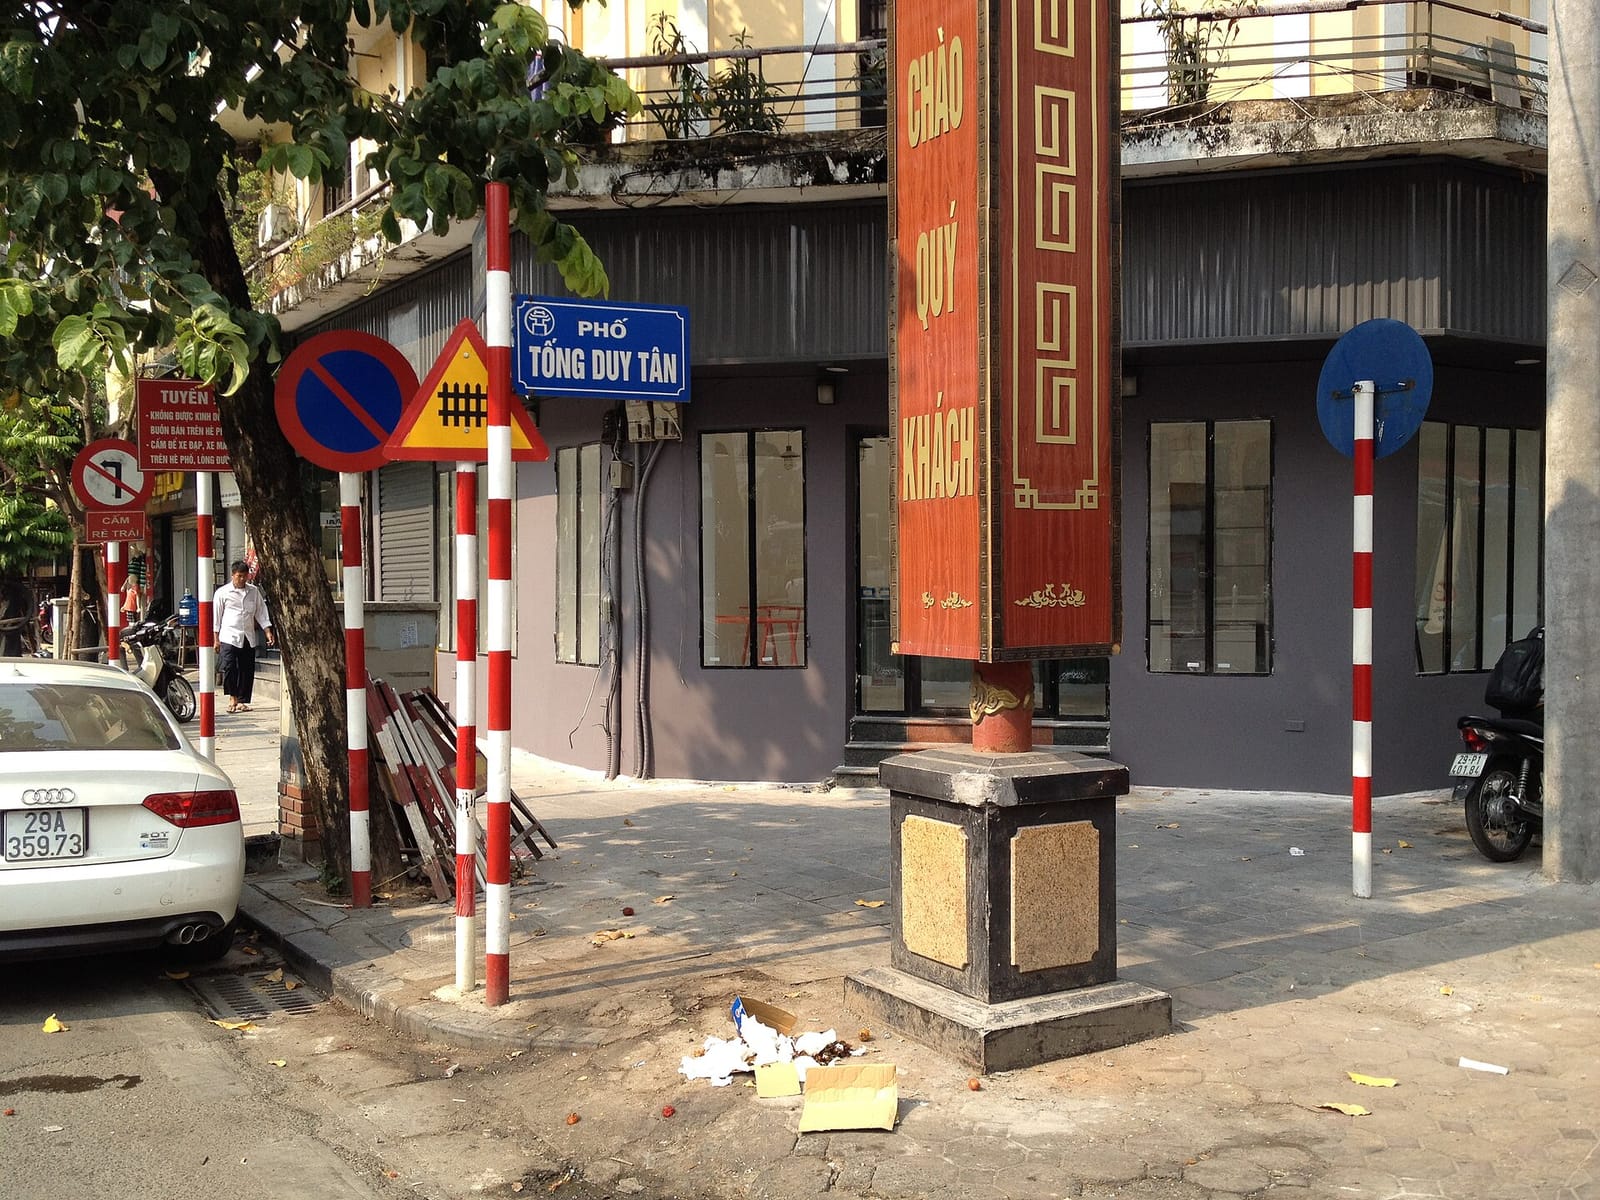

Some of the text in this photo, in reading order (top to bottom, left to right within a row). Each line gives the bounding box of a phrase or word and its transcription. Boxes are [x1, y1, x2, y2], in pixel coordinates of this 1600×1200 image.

[907, 26, 963, 149] CHÀO
[916, 199, 959, 331] QUÝ
[577, 317, 629, 339] PHỐ
[529, 337, 677, 384] TỐNG DUY TÂN
[150, 409, 174, 420] KHÔNG
[195, 412, 211, 421] KINH
[150, 424, 169, 435] BUÔN
[187, 425, 204, 436] TRÊN
[179, 441, 188, 450] XE
[206, 441, 215, 450] XE
[903, 391, 975, 501] KHÁCH
[150, 453, 168, 464] TRÊN
[102, 514, 130, 525] CẤM
[112, 528, 140, 538] TRÁI
[24, 810, 66, 834] 29A
[8, 833, 82, 859] 359.73
